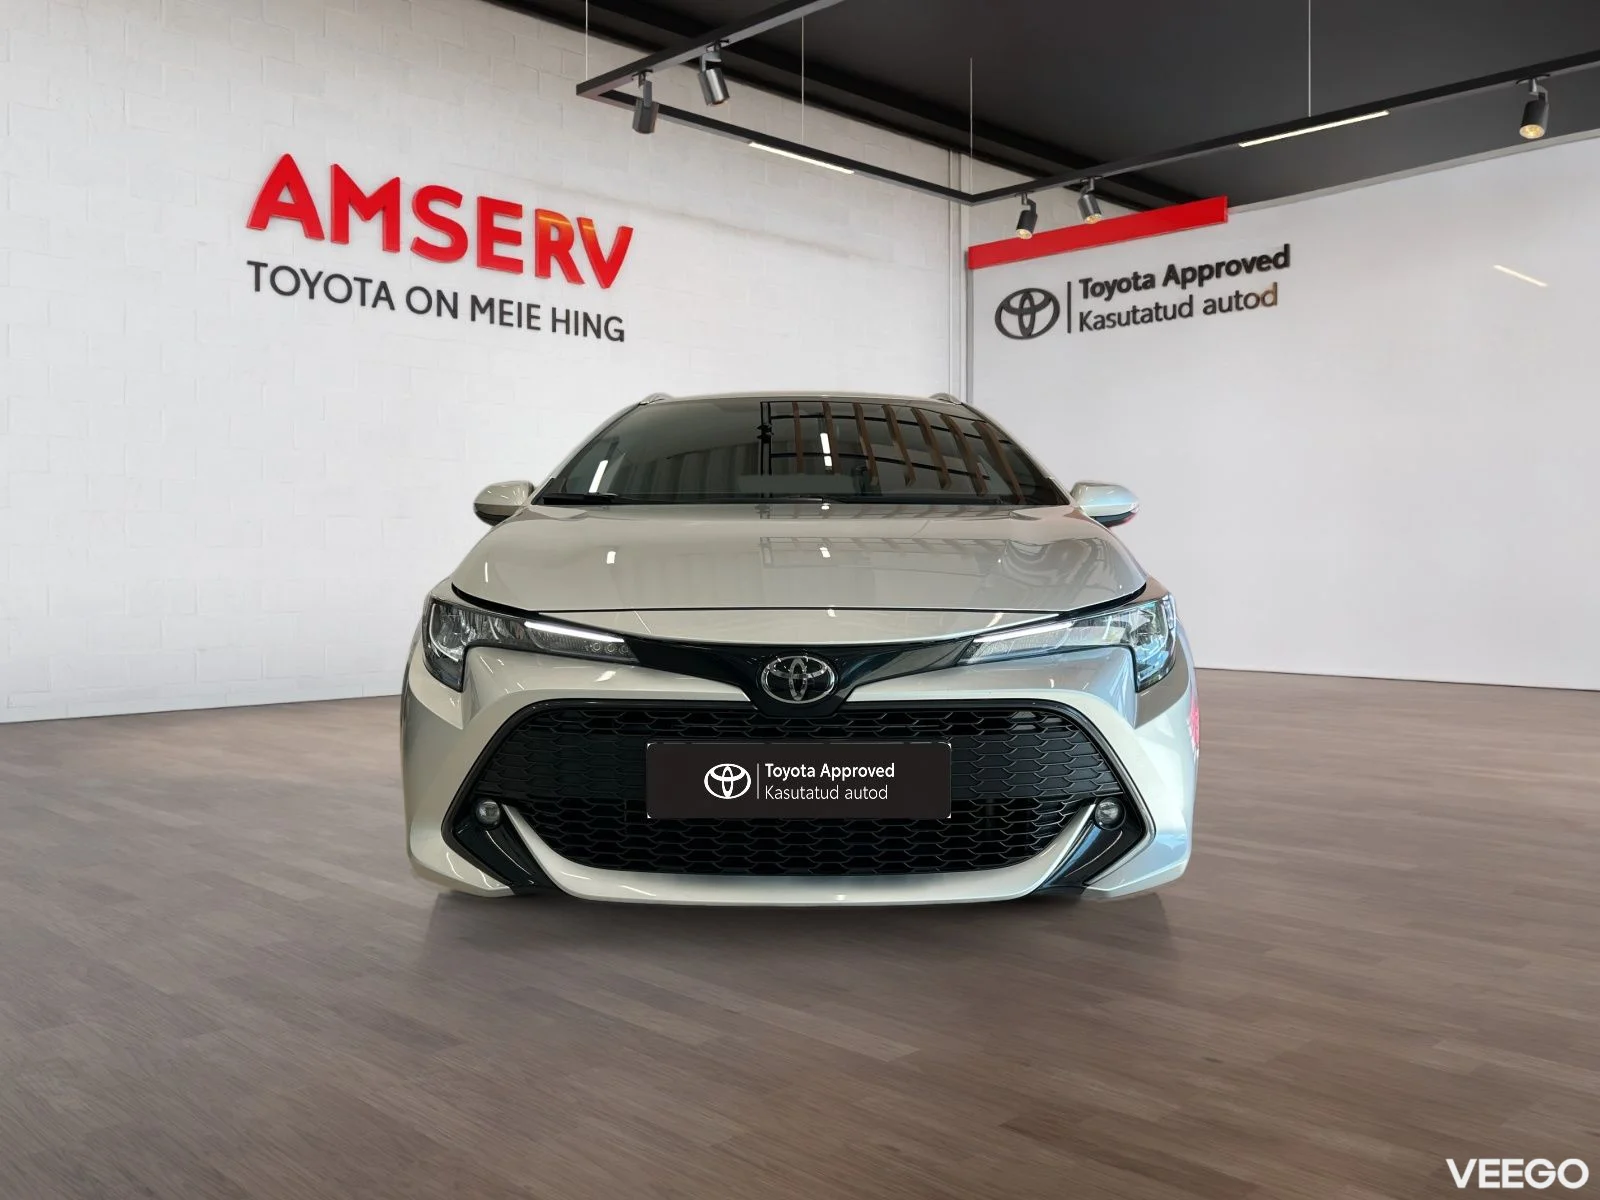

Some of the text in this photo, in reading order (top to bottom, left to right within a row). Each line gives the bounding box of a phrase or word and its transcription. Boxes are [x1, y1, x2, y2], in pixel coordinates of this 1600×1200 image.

[246, 153, 633, 289] AMSERV
[1079, 243, 1290, 301] Toyota Approved
[247, 260, 625, 342] TOYOTA ON MEIE HING
[1079, 282, 1278, 332] Kasutatud autod
[765, 762, 895, 781] Toyota Approved
[765, 784, 888, 800] Kasutatud autod
